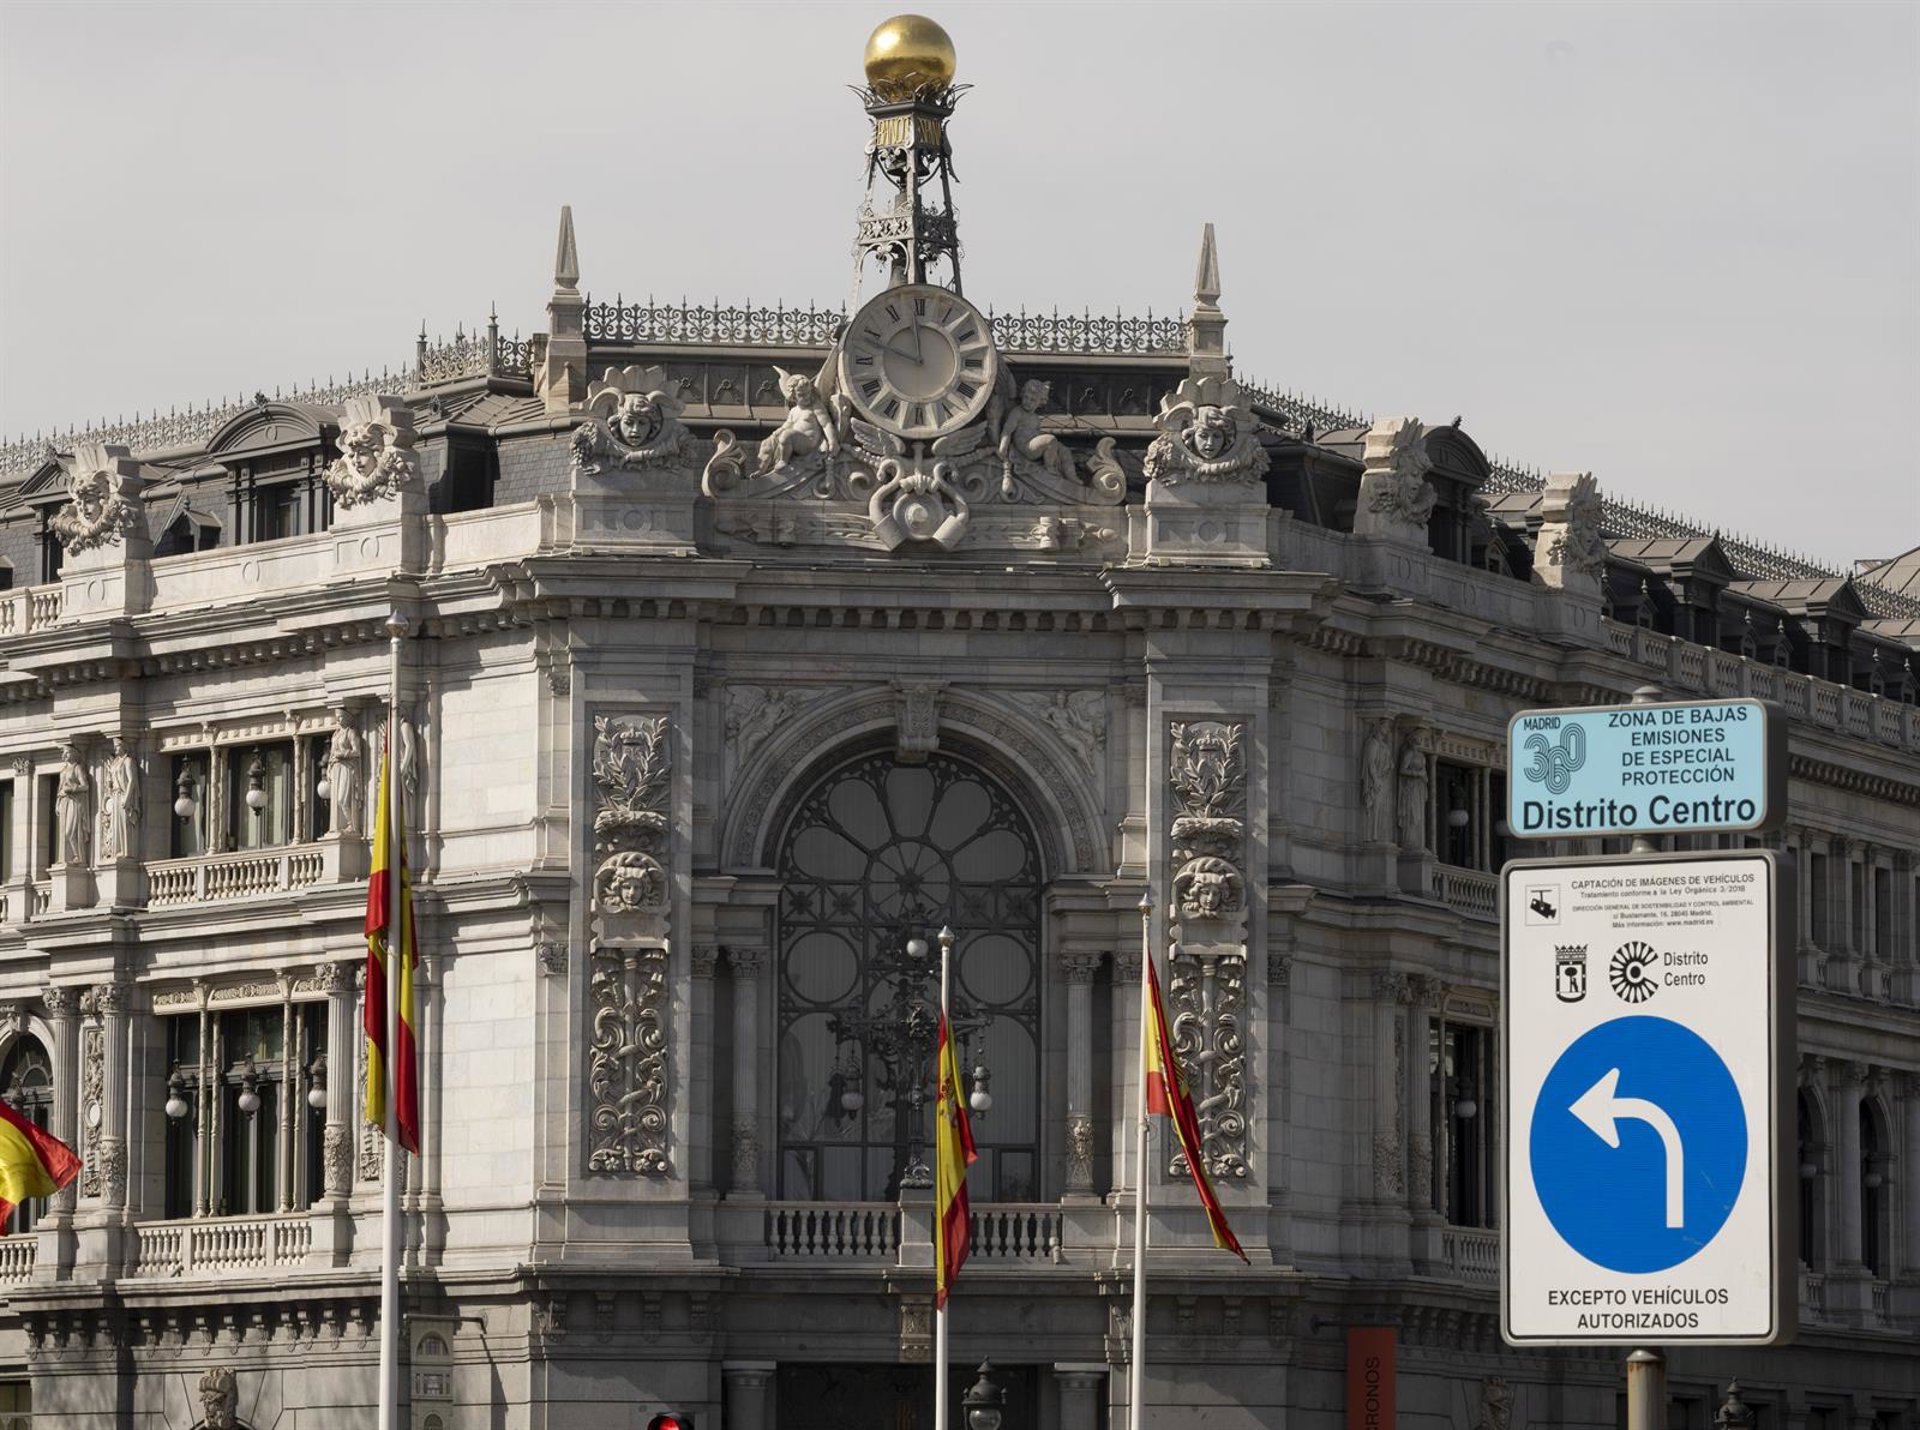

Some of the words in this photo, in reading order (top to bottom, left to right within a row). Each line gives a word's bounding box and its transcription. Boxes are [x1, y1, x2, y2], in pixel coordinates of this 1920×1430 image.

[1523, 717, 1561, 731] MADRID
[1608, 712, 1657, 729] ZONA
[1661, 709, 1685, 725] DE
[1690, 706, 1748, 724] BAJAS
[1631, 727, 1726, 747] EMISIONES
[1523, 722, 1586, 795] 360
[1622, 751, 1645, 767] DE
[1650, 748, 1735, 765] ESPECIAL
[1622, 765, 1735, 786] PROTECCIÓN
[1523, 797, 1638, 830] Distrito
[1649, 794, 1756, 825] Centro
[1571, 878, 1623, 890] CAPTACIÓN
[1625, 878, 1638, 888] DE
[1639, 876, 1686, 887] IMÁGENES
[1688, 875, 1701, 885] DE
[1703, 873, 1755, 884] VEHÍCULOS
[1669, 887, 1682, 896] Ley
[1664, 951, 1709, 966] Distrito
[1664, 972, 1706, 986] Centro
[1548, 1289, 1626, 1305] EXCEPTO
[1632, 1285, 1729, 1304] VEHÍCULOS
[1577, 1312, 1699, 1329] AUTORIZADOS
[1365, 1356, 1380, 1430] RONOS
